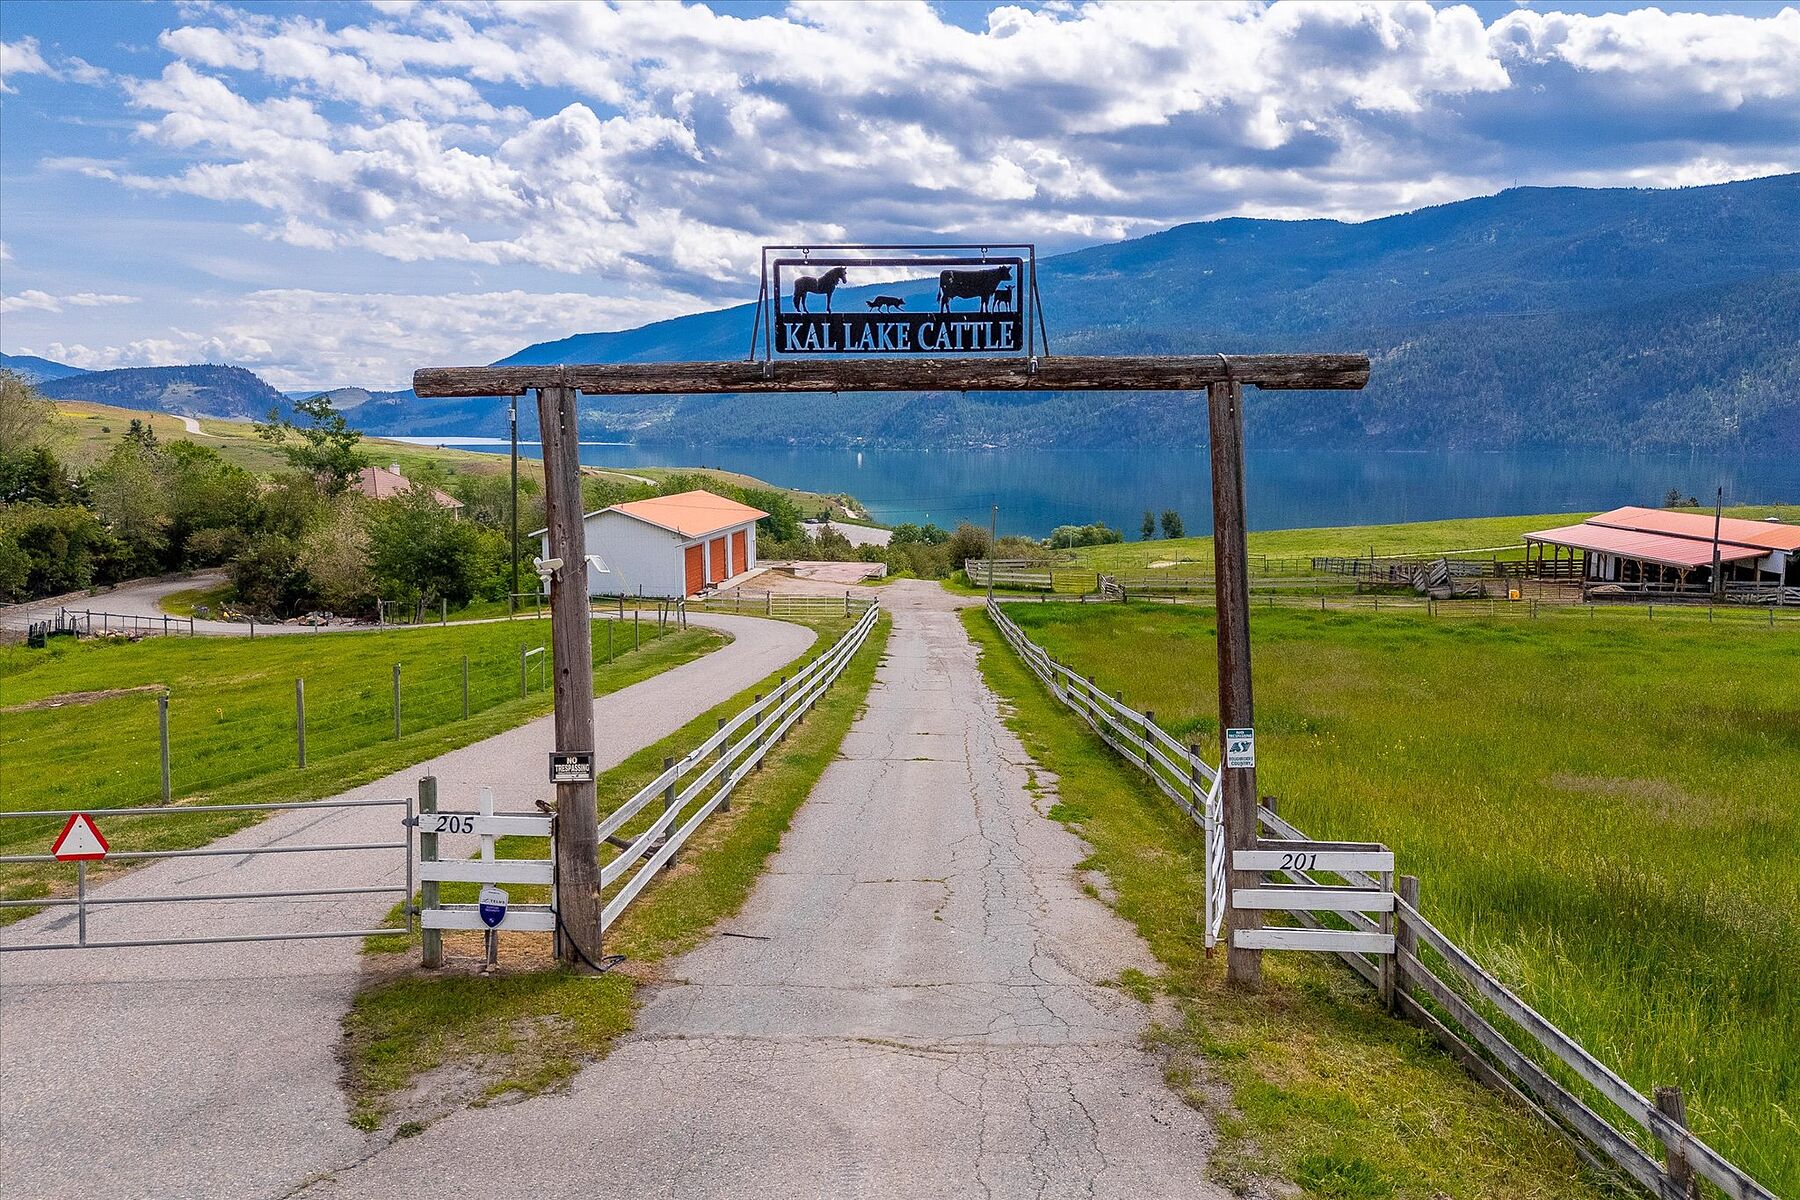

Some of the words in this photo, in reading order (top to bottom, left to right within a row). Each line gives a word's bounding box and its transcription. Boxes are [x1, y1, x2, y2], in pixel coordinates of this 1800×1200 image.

[784, 322, 837, 350] KAL
[843, 322, 911, 350] LAKE
[917, 321, 1014, 350] CATTLE
[554, 764, 590, 772] TRESPASSING
[566, 756, 578, 764] NO
[434, 815, 474, 834] 205
[1279, 852, 1317, 871] 201
